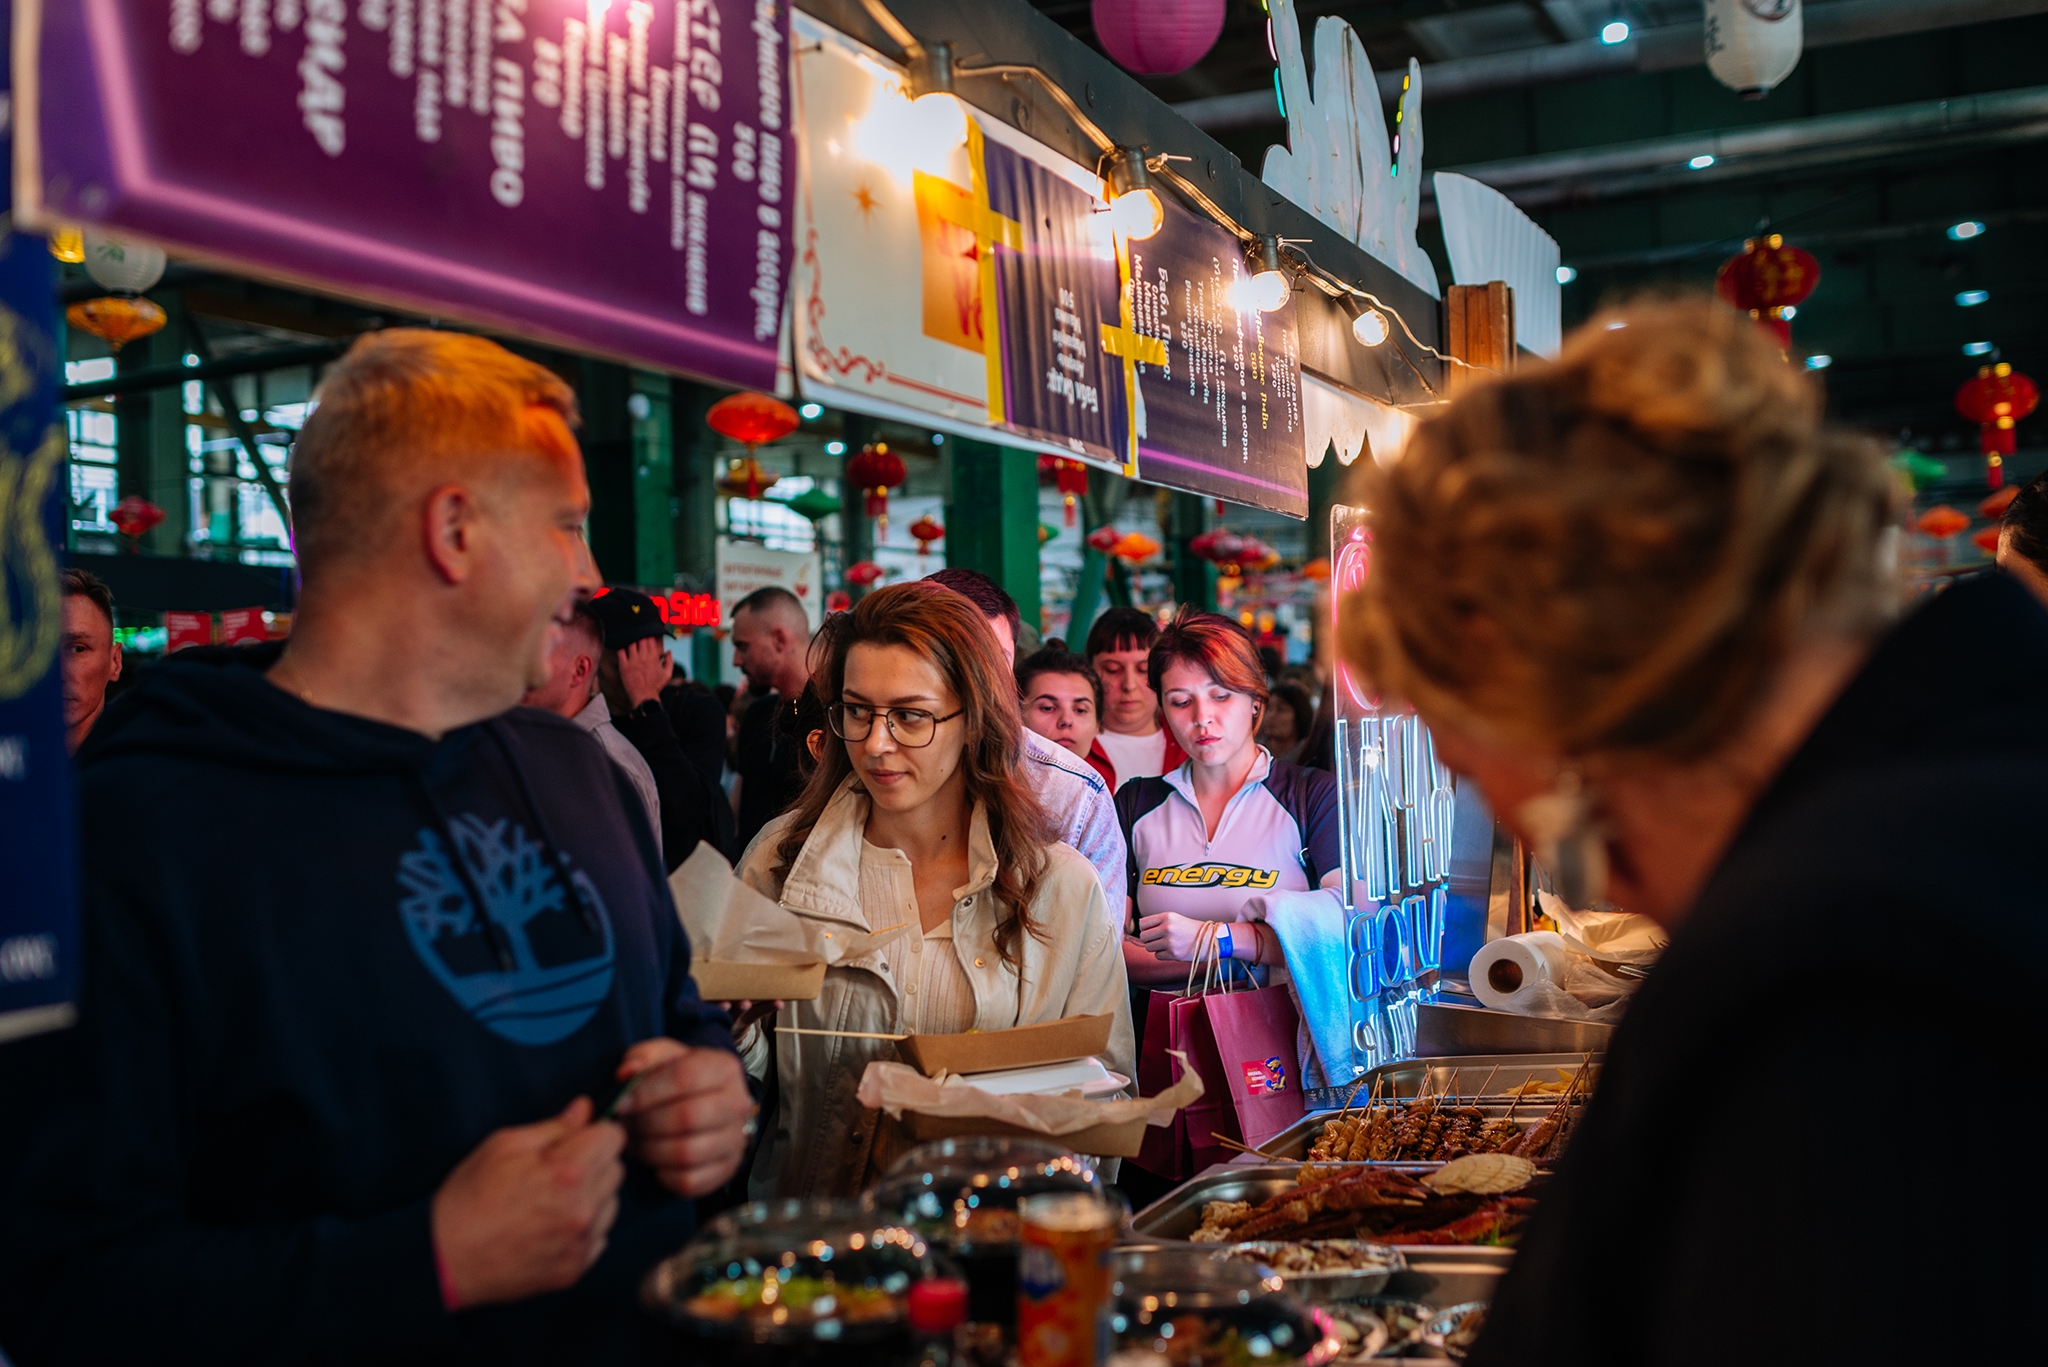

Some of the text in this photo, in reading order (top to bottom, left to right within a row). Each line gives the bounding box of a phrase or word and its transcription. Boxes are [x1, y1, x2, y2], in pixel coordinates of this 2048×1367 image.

[1142, 281, 1152, 336] Мараку
[1151, 284, 1160, 341] Сливочн
[1158, 267, 1170, 316] Бабл
[1200, 336, 1210, 404] Маракуйя
[1206, 320, 1214, 374] Конопля
[1250, 352, 1258, 380] 500
[1142, 866, 1280, 889] energy
